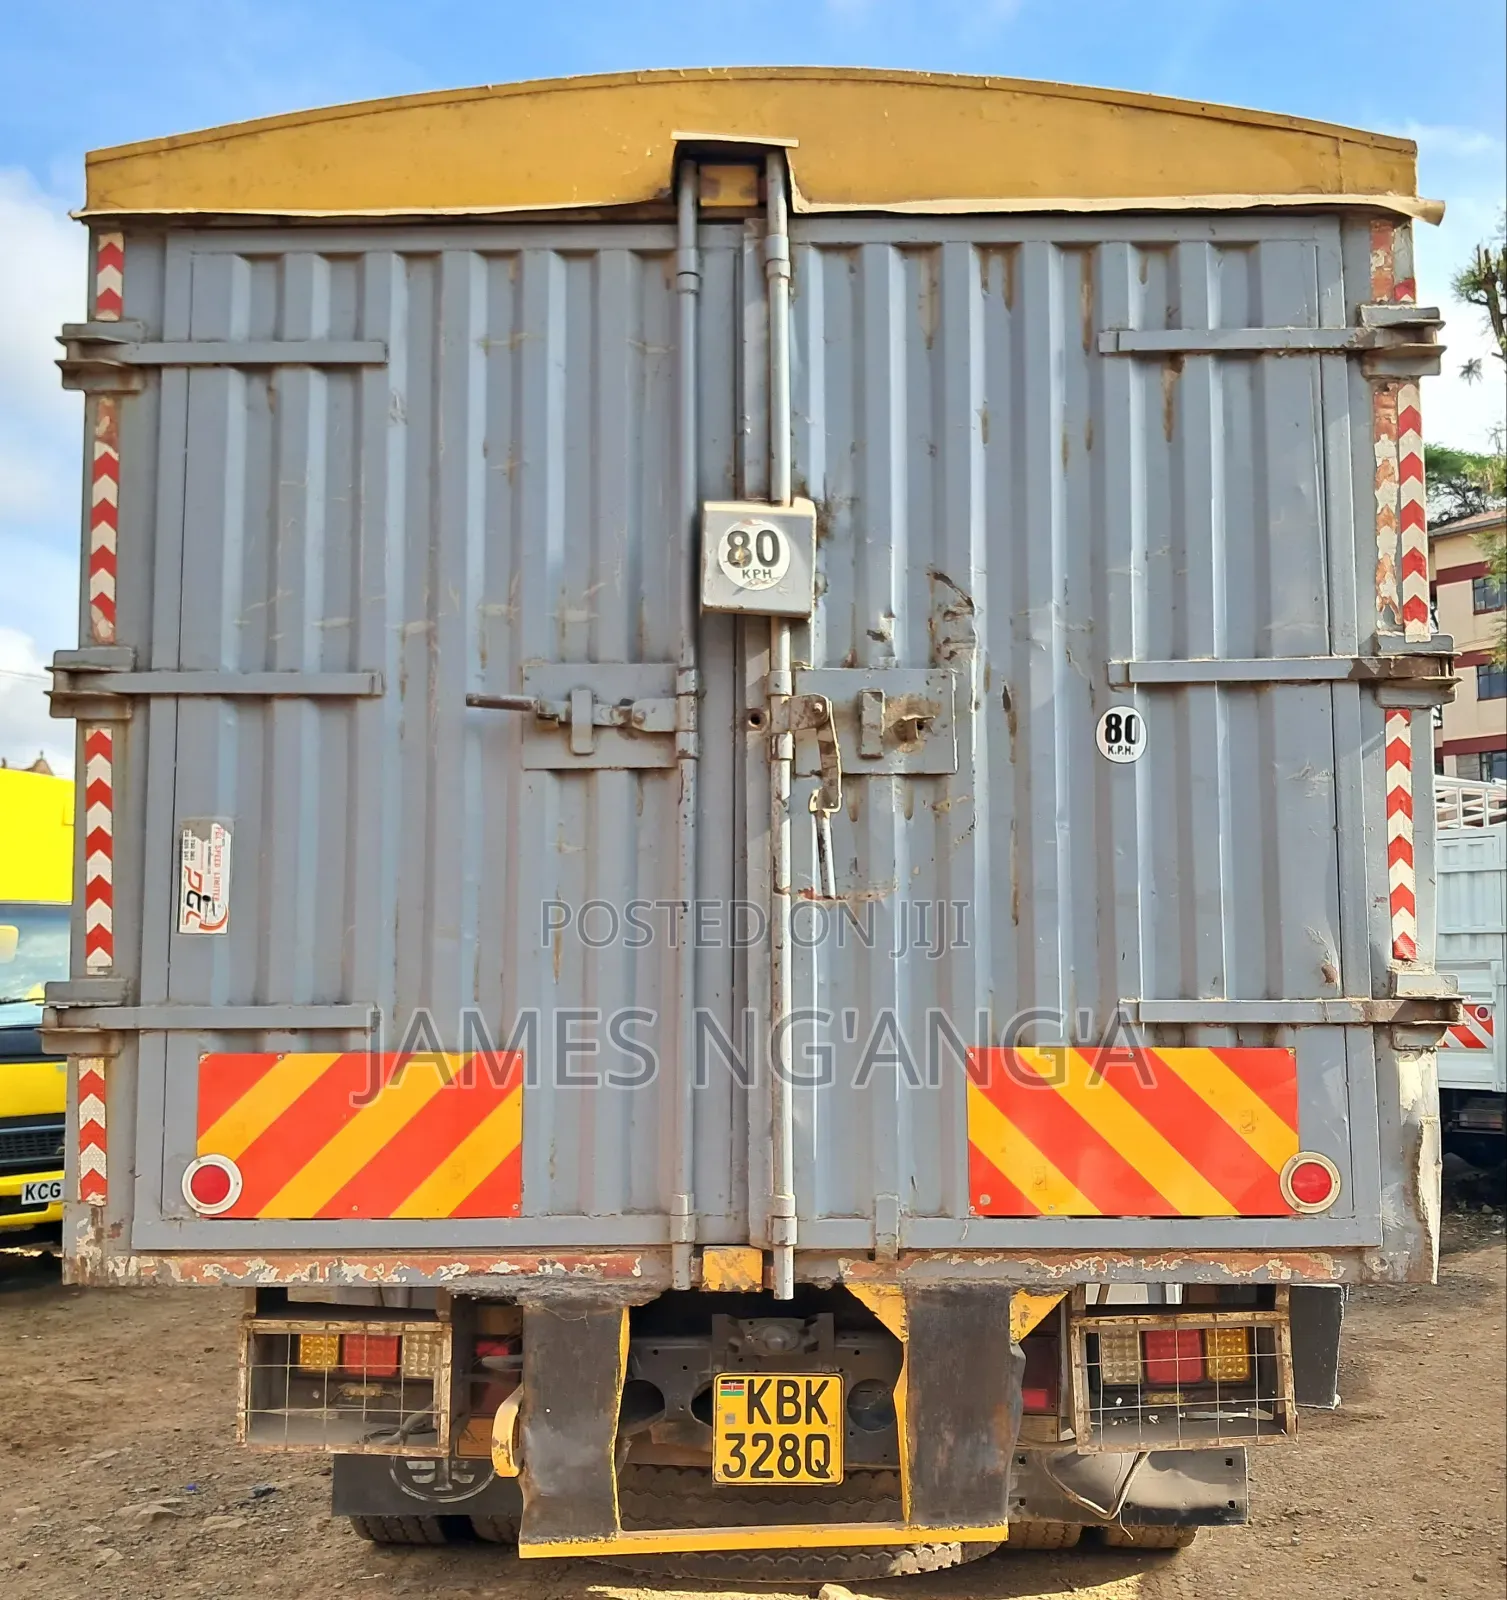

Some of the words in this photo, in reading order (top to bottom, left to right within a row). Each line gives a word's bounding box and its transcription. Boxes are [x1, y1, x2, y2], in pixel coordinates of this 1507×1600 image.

[727, 529, 780, 569] 80
[742, 569, 772, 579] KPH
[1105, 713, 1140, 745] 80
[1108, 745, 1134, 755] K.P.H.
[214, 845, 222, 868] SPEED
[25, 1182, 61, 1201] KCG
[747, 1379, 830, 1425] KBK
[722, 1433, 831, 1478] 328Q
